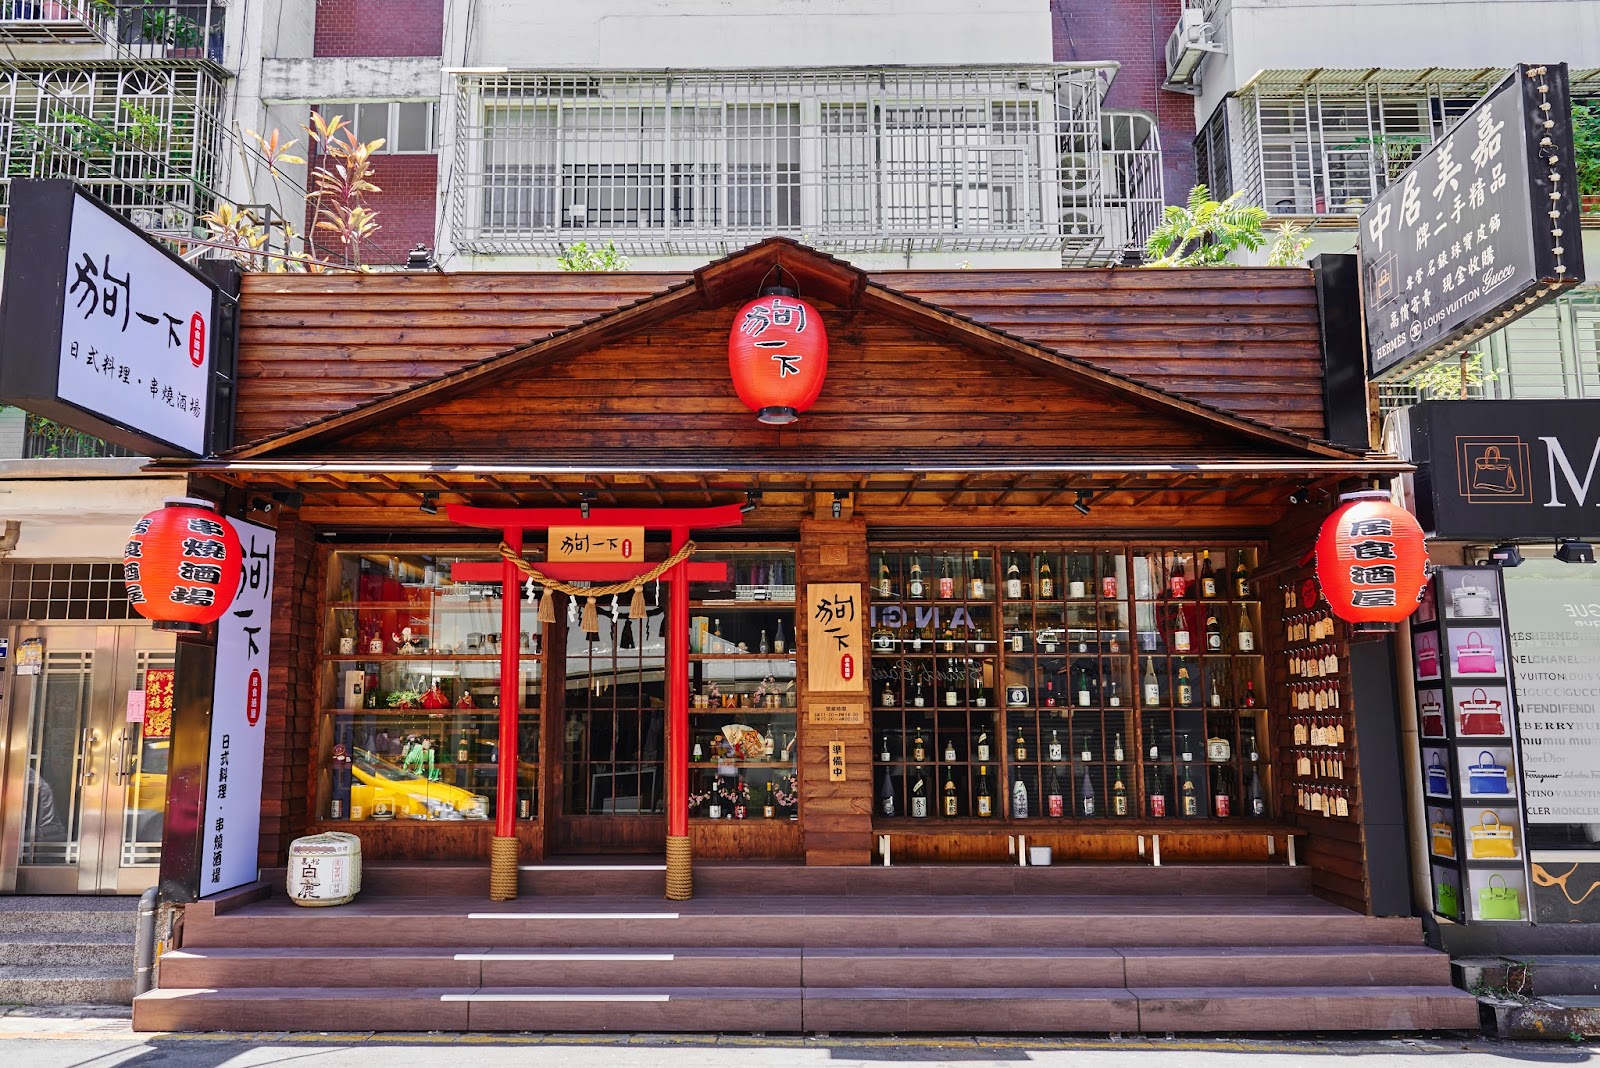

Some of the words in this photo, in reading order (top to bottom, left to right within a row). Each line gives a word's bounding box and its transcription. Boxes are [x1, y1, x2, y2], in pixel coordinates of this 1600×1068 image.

[1423, 309, 1446, 331] LOUIS
[1446, 286, 1480, 316] VUITTON
[169, 518, 226, 607] 串燒酒場
[1520, 672, 1565, 681] VUITTON
[1521, 722, 1575, 730] BERRY
[832, 744, 843, 777] 準備中
[1551, 806, 1599, 816] MONCLER
